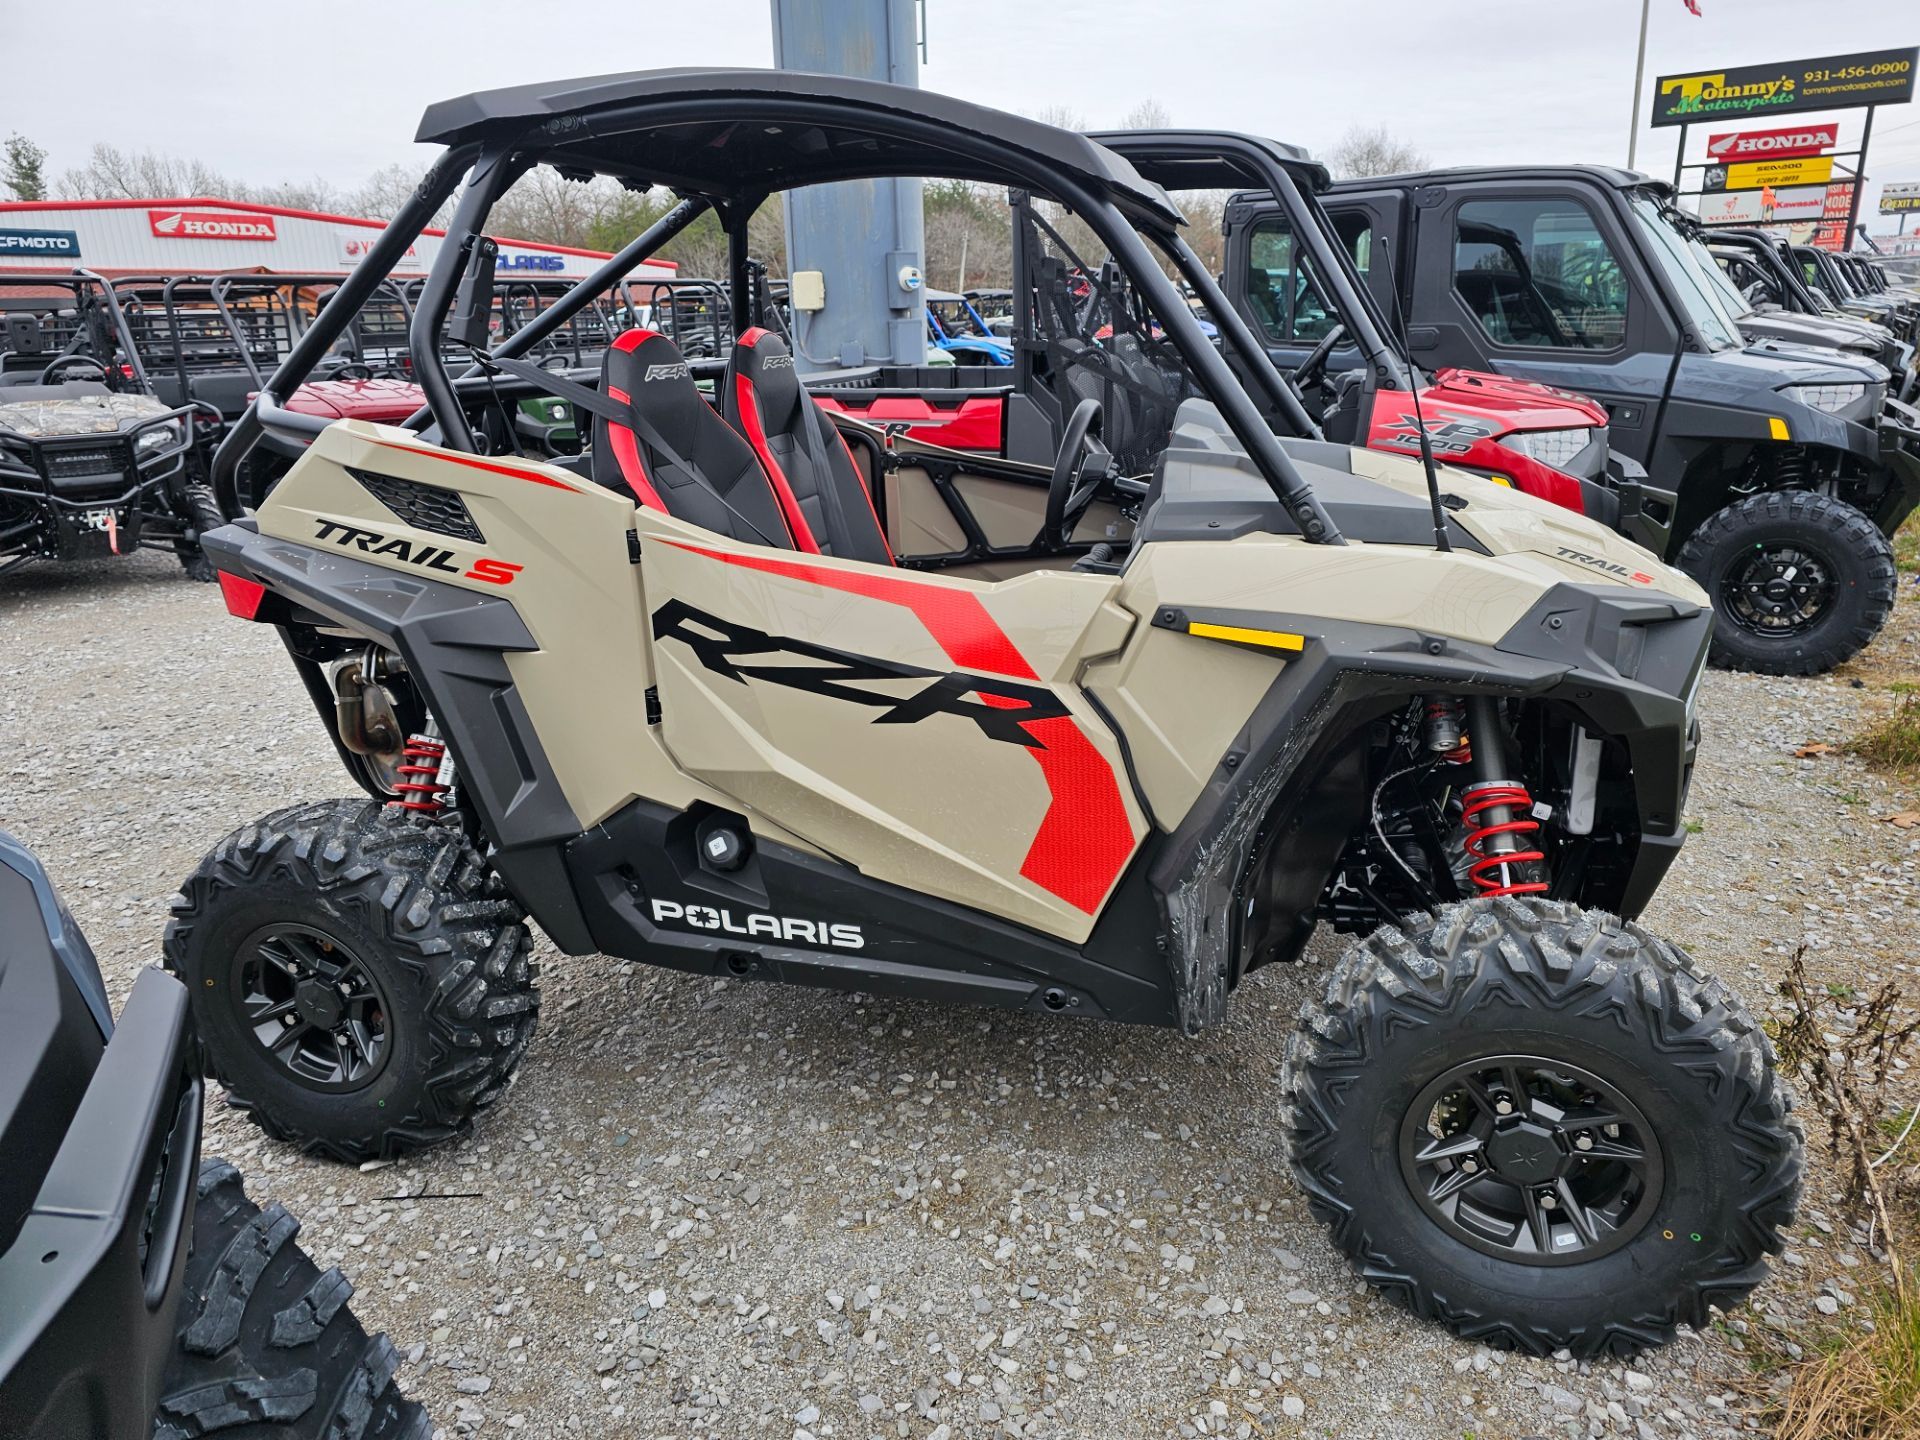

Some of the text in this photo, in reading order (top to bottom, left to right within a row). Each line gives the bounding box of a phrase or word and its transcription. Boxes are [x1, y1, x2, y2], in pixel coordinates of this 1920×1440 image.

[1804, 61, 1909, 83] 931-456-0900
[1661, 73, 1796, 108] Tommy's
[1802, 78, 1906, 96] tommysmotorsports.com
[1666, 92, 1795, 116] Motorsports
[1736, 132, 1833, 152] HONDA
[1776, 199, 1823, 208] Kawasaki
[182, 221, 275, 236] HONDA
[645, 362, 688, 382] RZR
[762, 354, 797, 370] RZR
[1378, 413, 1493, 438] XP
[1396, 434, 1473, 453] 1000
[315, 518, 524, 585] TRAIL S
[1557, 547, 1655, 584] TRAIL S
[652, 598, 1074, 750] RZR
[651, 899, 865, 949] POLARIS
